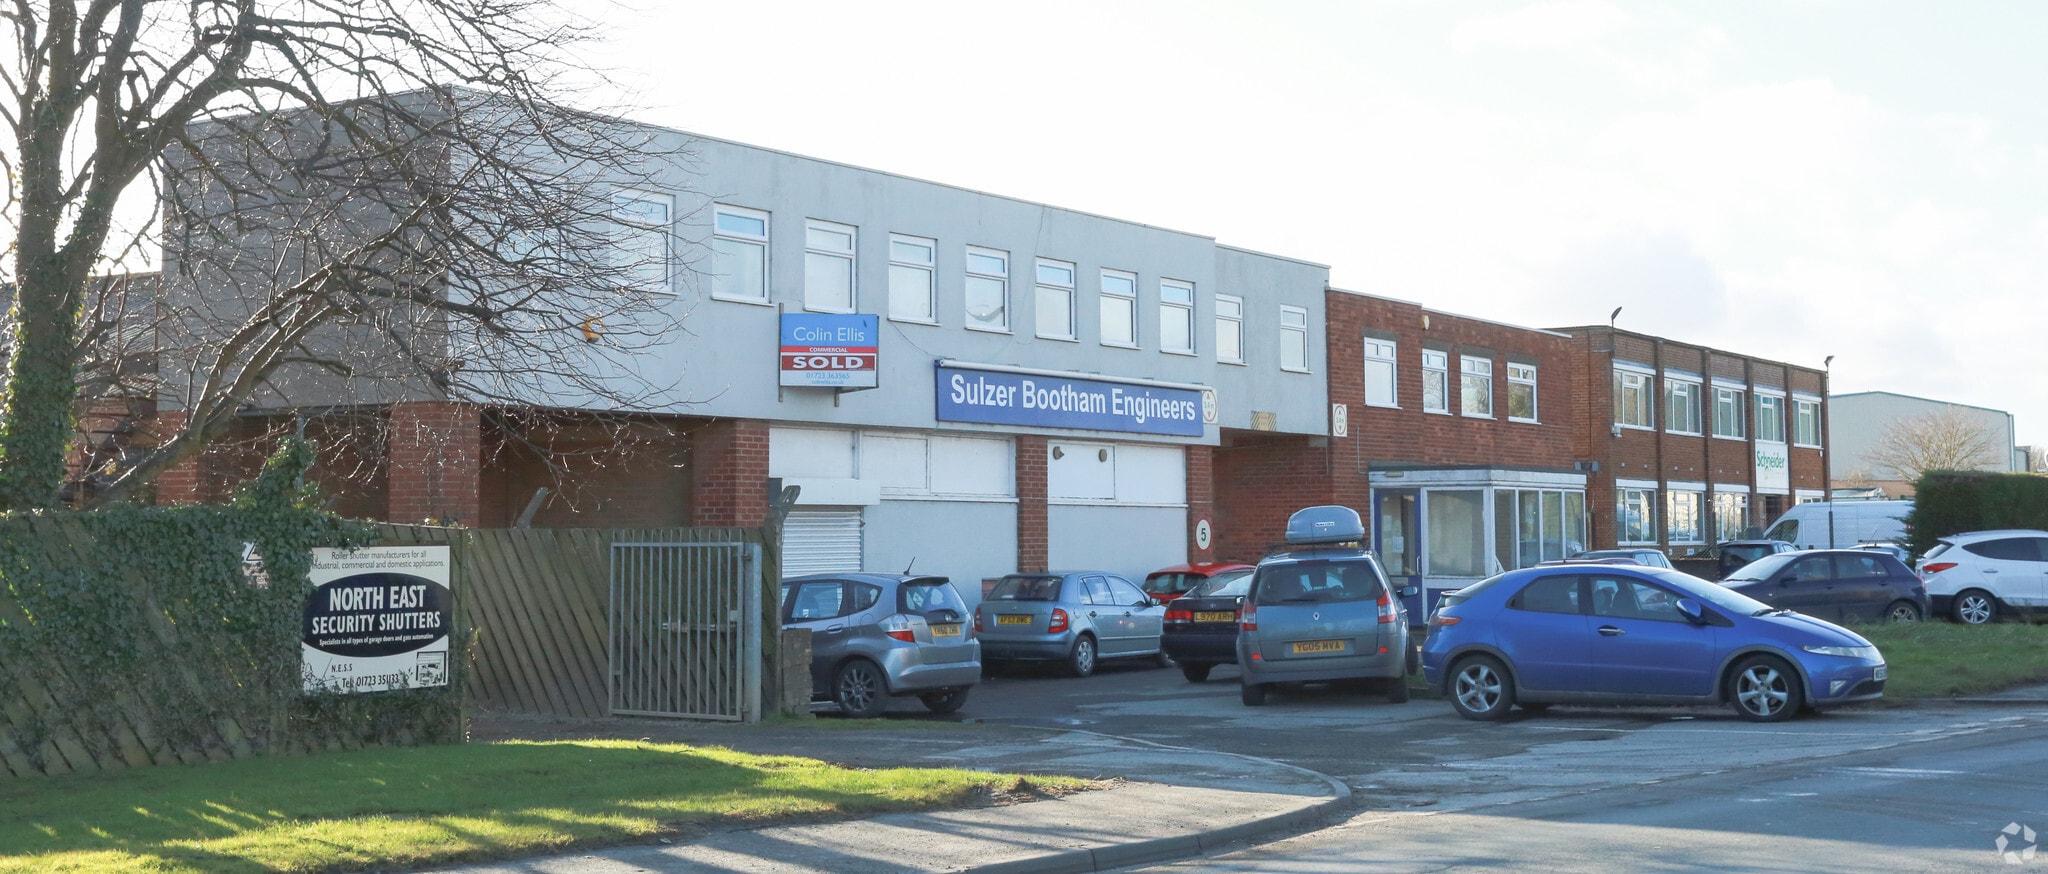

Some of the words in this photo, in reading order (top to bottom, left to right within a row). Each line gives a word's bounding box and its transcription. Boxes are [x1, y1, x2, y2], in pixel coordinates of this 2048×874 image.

[793, 326, 832, 341] Colin
[838, 327, 865, 342] Ellis
[792, 356, 864, 369] SOLD
[951, 374, 1017, 407] Sulzer
[1022, 380, 1106, 415] Bootham
[1112, 388, 1196, 425] Engineers
[1756, 450, 1785, 470] Schneider
[1200, 527, 1207, 542] 5
[331, 551, 349, 560] Roller
[350, 551, 370, 560] shutter
[371, 550, 411, 559] manufacturers
[411, 550, 420, 558] for
[341, 560, 375, 569] commercial
[375, 560, 386, 568] and
[387, 559, 412, 568] domestic
[330, 586, 384, 611] NORTH
[390, 585, 427, 609] EAST
[1195, 612, 1215, 620] L970
[312, 614, 376, 635] SECURITY
[380, 611, 441, 631] SHUTTERS
[368, 636, 382, 645] garage
[1297, 641, 1320, 651] YG05
[331, 663, 353, 673] N.E.S.S
[356, 674, 377, 687] 01723
